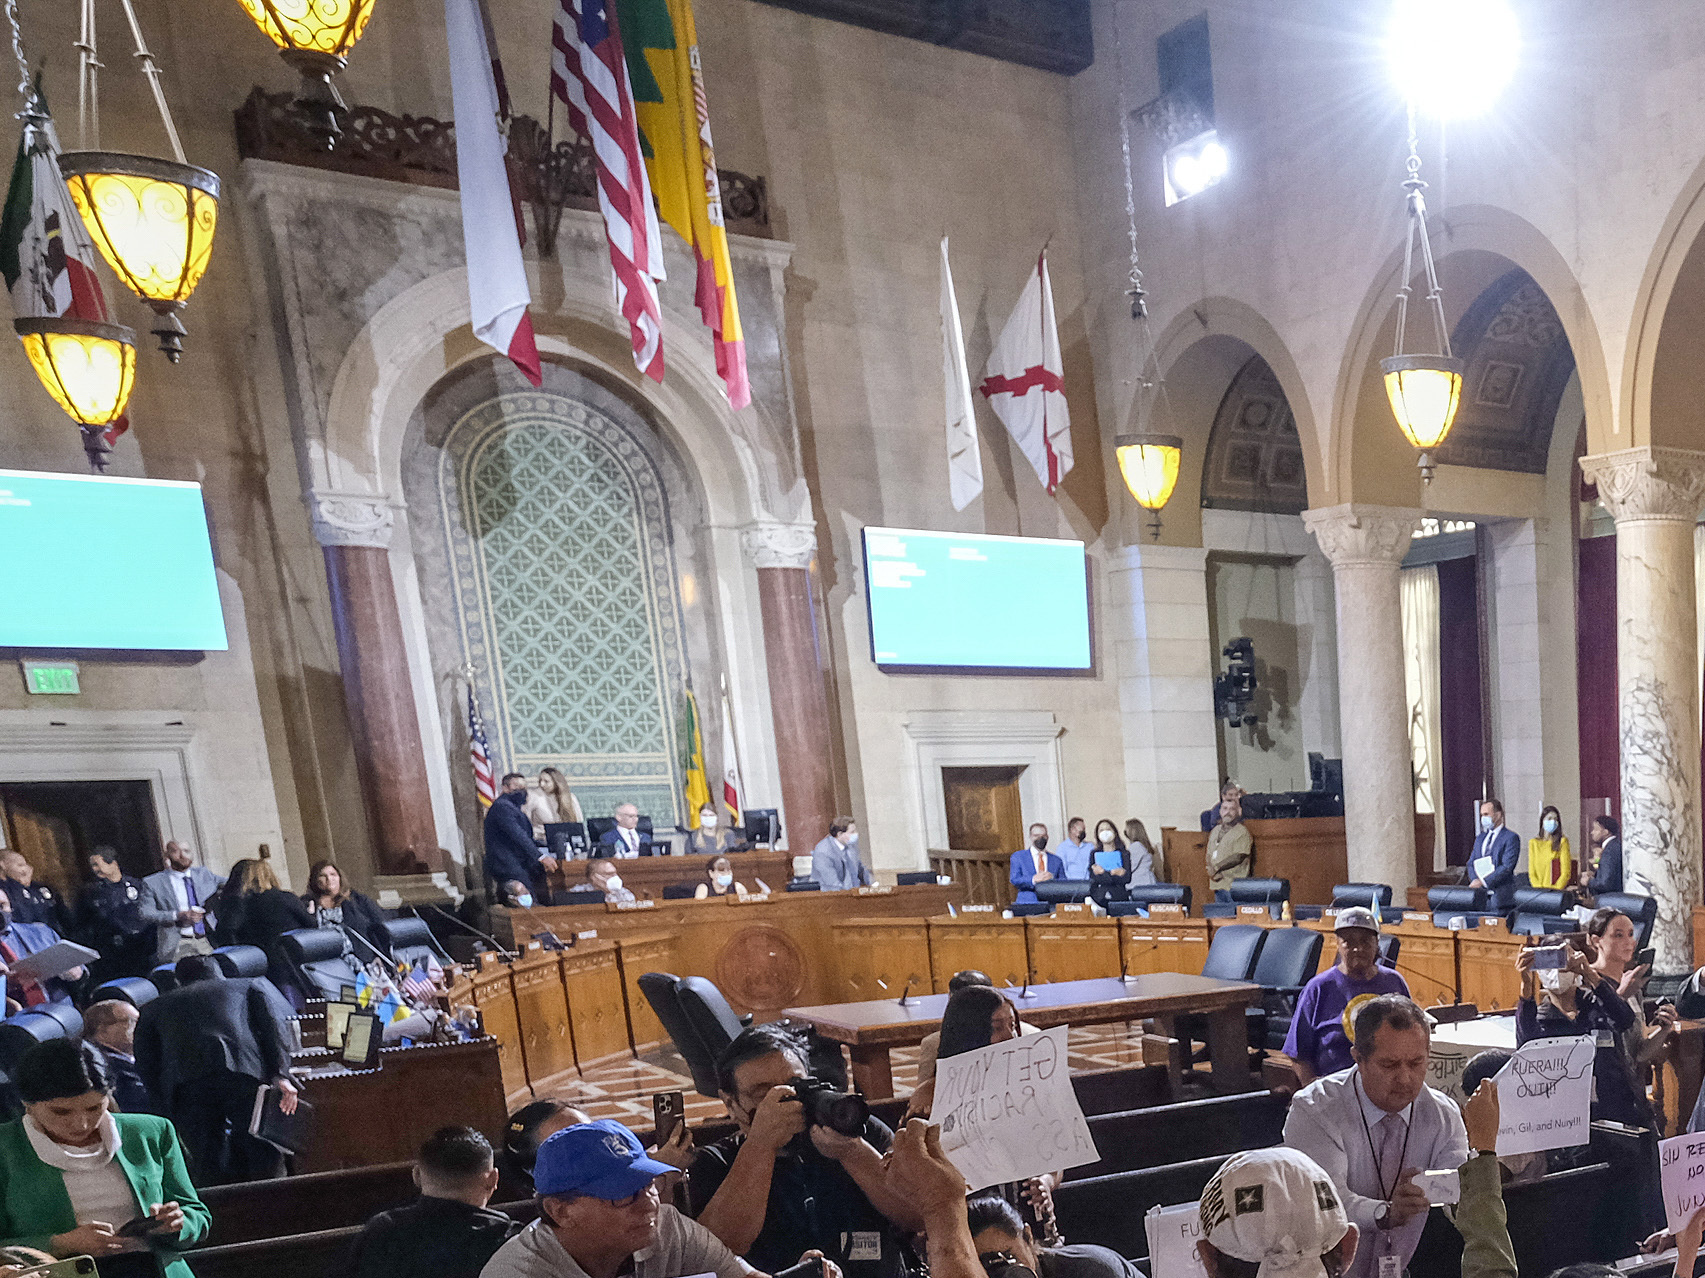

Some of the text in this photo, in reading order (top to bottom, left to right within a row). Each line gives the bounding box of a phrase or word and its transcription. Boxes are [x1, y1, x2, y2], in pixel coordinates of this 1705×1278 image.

[32, 668, 73, 690] EXIT
[1536, 1120, 1553, 1131] and
[1662, 1147, 1680, 1167] SIN
[1688, 1164, 1704, 1180] NO
